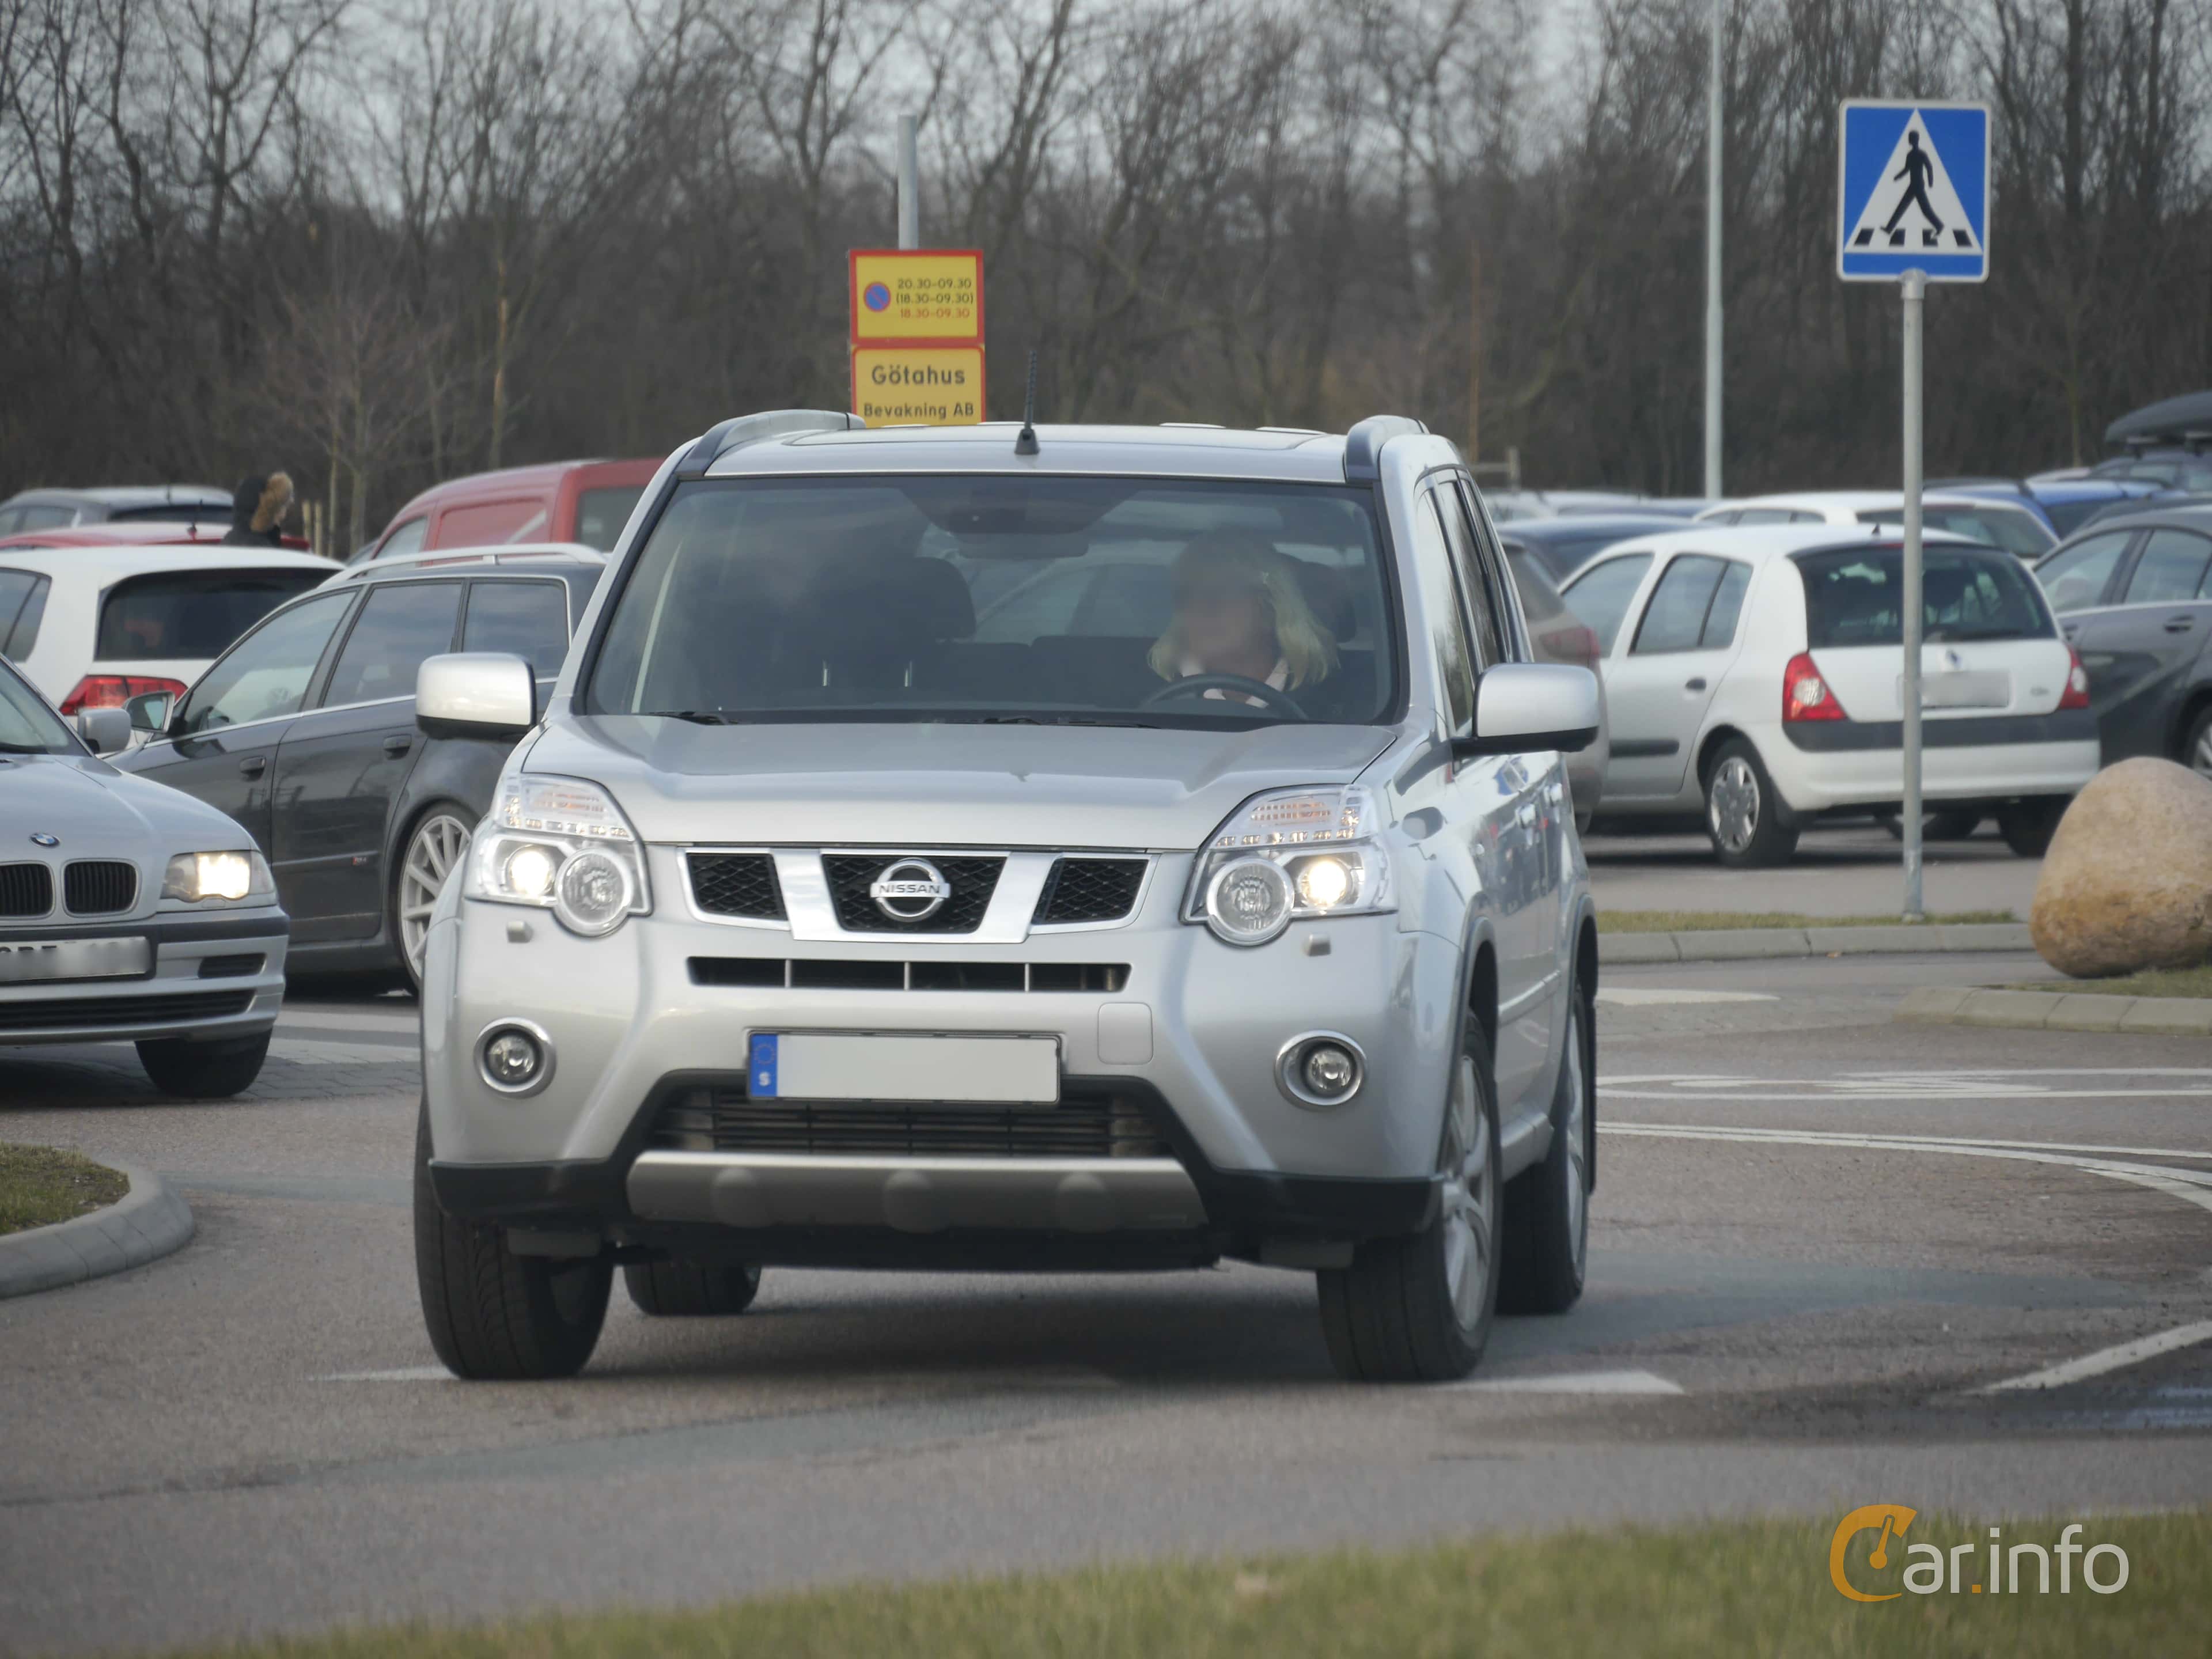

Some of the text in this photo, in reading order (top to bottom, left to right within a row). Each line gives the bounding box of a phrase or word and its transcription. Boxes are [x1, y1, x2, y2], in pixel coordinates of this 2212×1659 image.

[898, 278, 972, 289] 20.30-09.30
[872, 364, 965, 385] Götahus
[864, 403, 974, 419] Bevakning AB
[879, 884, 940, 894] NISSAN
[759, 1072, 770, 1086] S
